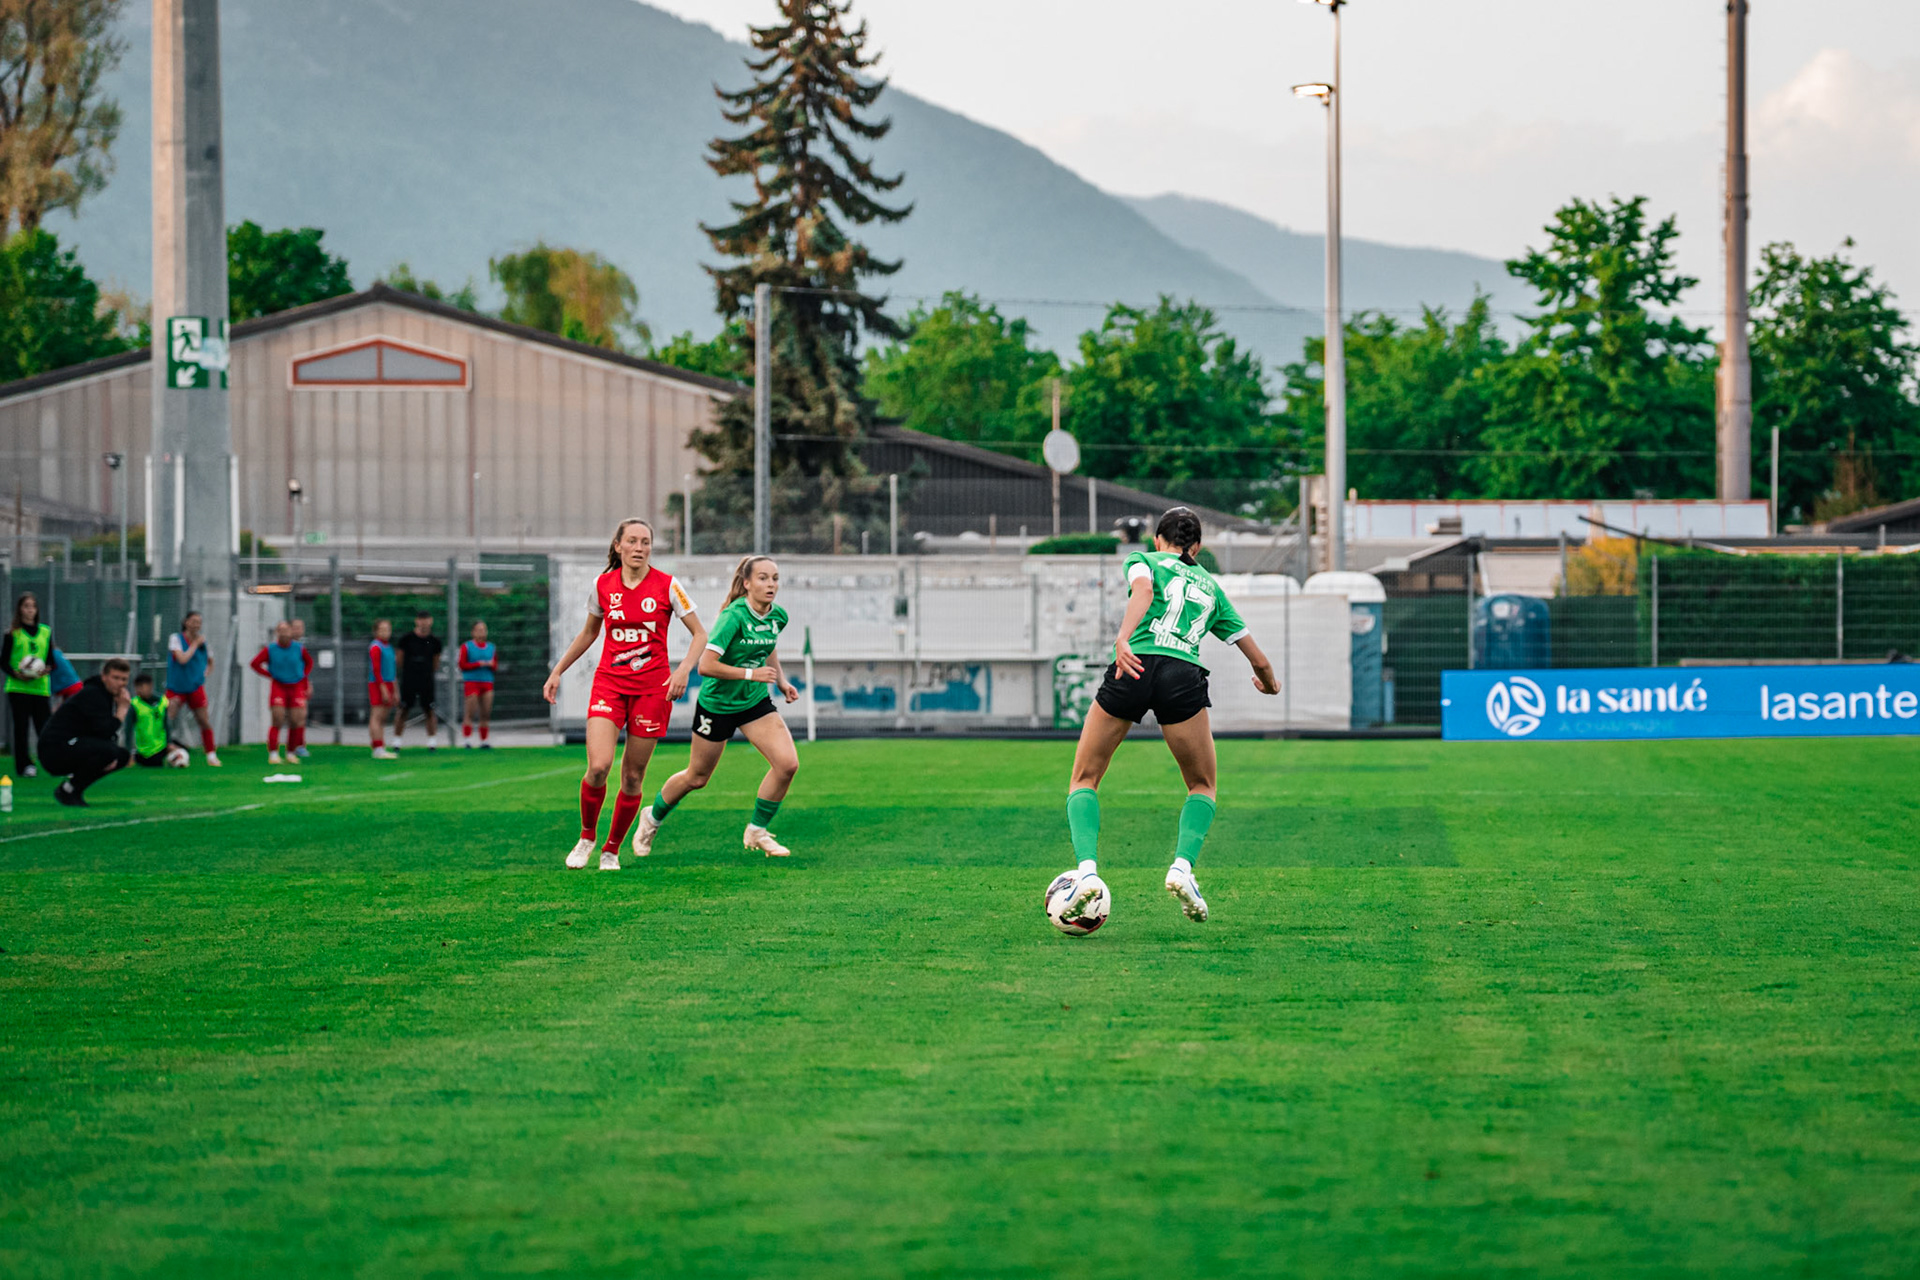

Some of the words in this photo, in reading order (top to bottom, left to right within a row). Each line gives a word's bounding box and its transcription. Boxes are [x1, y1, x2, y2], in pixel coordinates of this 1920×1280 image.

[1149, 576, 1216, 646] 17
[611, 628, 650, 642] OBT
[1556, 684, 1591, 714] la
[1597, 677, 1708, 713] santé
[1760, 684, 1918, 721] lasante
